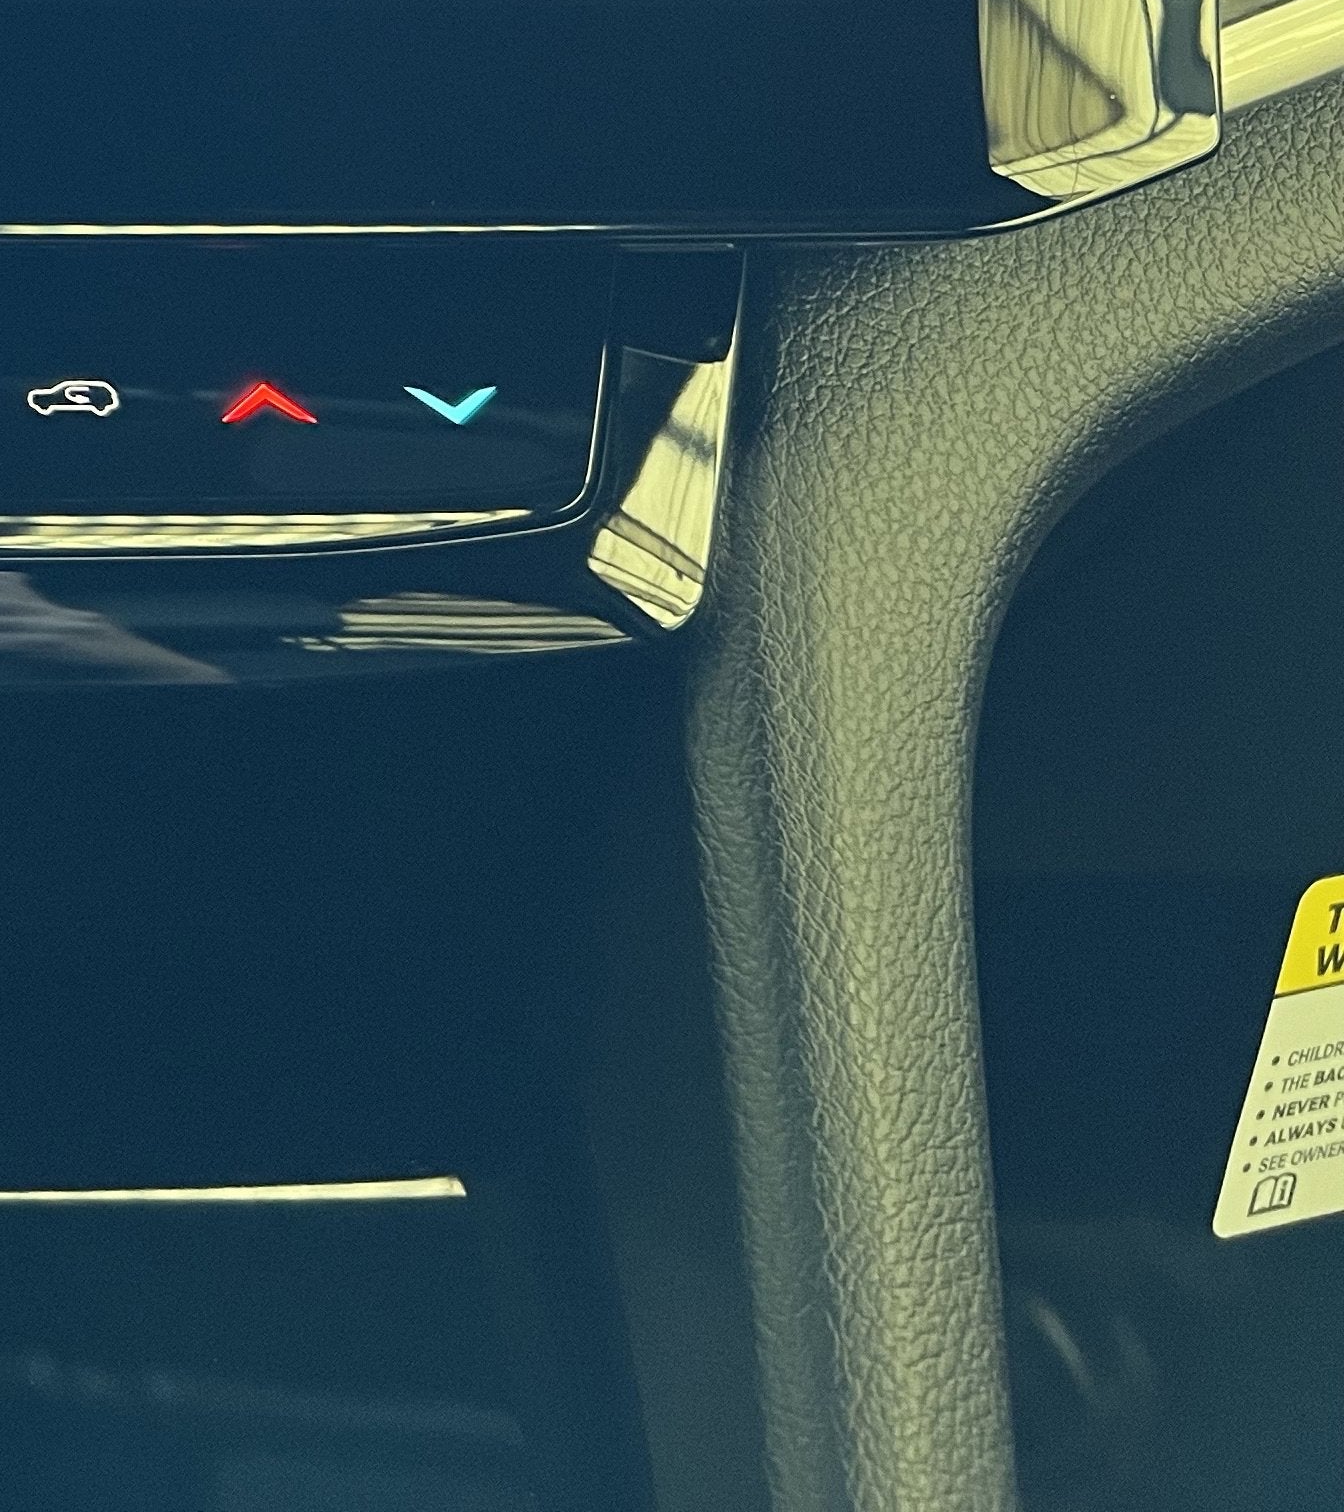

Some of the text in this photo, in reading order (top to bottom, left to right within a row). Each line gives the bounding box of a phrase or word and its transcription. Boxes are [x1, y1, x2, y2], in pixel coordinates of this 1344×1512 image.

[1281, 1072, 1312, 1094] THE
[1272, 1094, 1331, 1121] NEVER
[1264, 1117, 1338, 1147] ALWAYS
[1258, 1153, 1289, 1173] SEE
